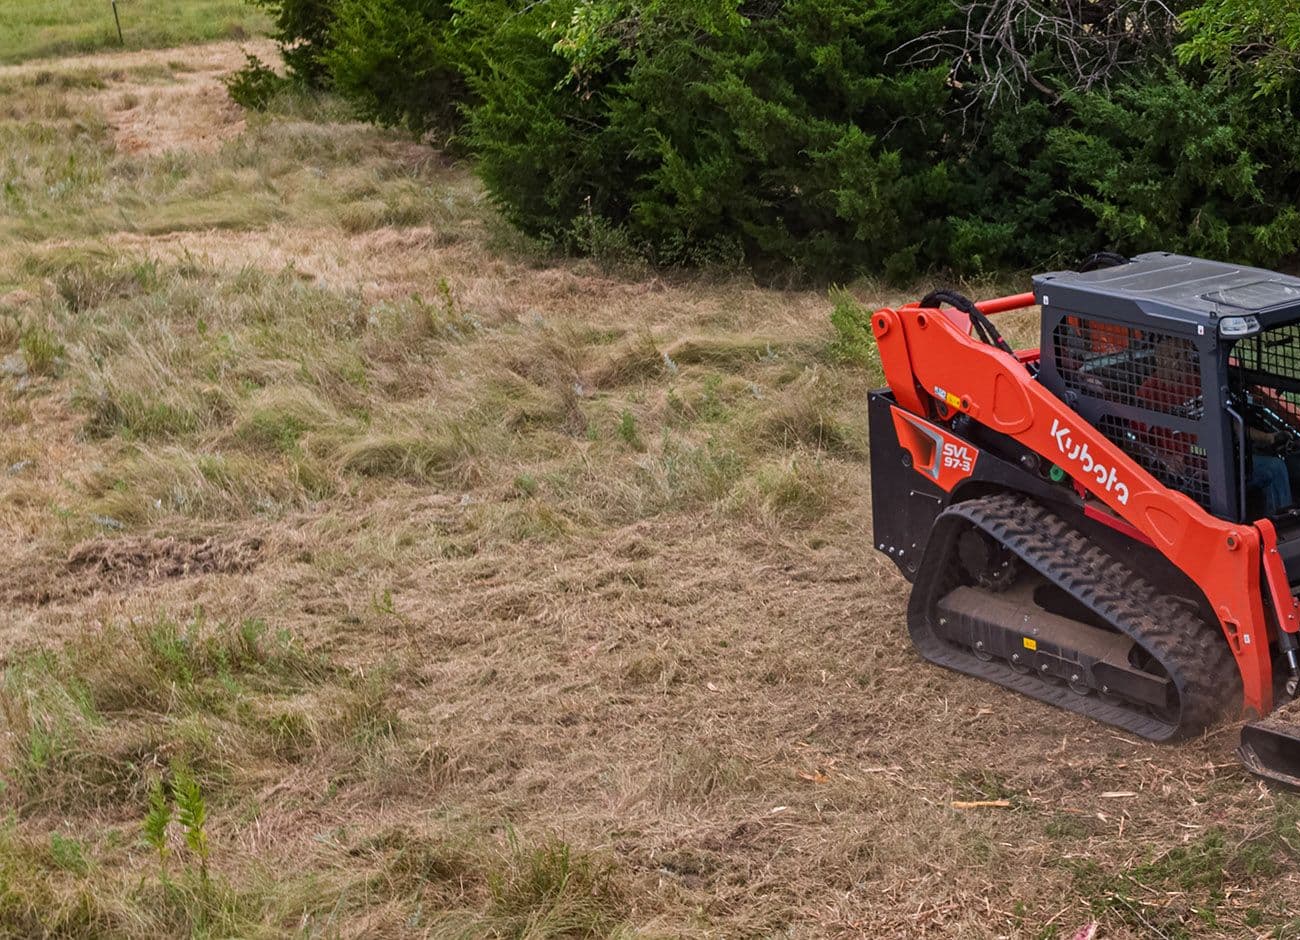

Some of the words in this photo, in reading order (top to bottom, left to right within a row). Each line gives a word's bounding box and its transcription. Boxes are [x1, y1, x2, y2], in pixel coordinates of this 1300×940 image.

[943, 443, 973, 461] SVL
[944, 456, 971, 472] 97-3
[1050, 419, 1129, 506] Kubota
